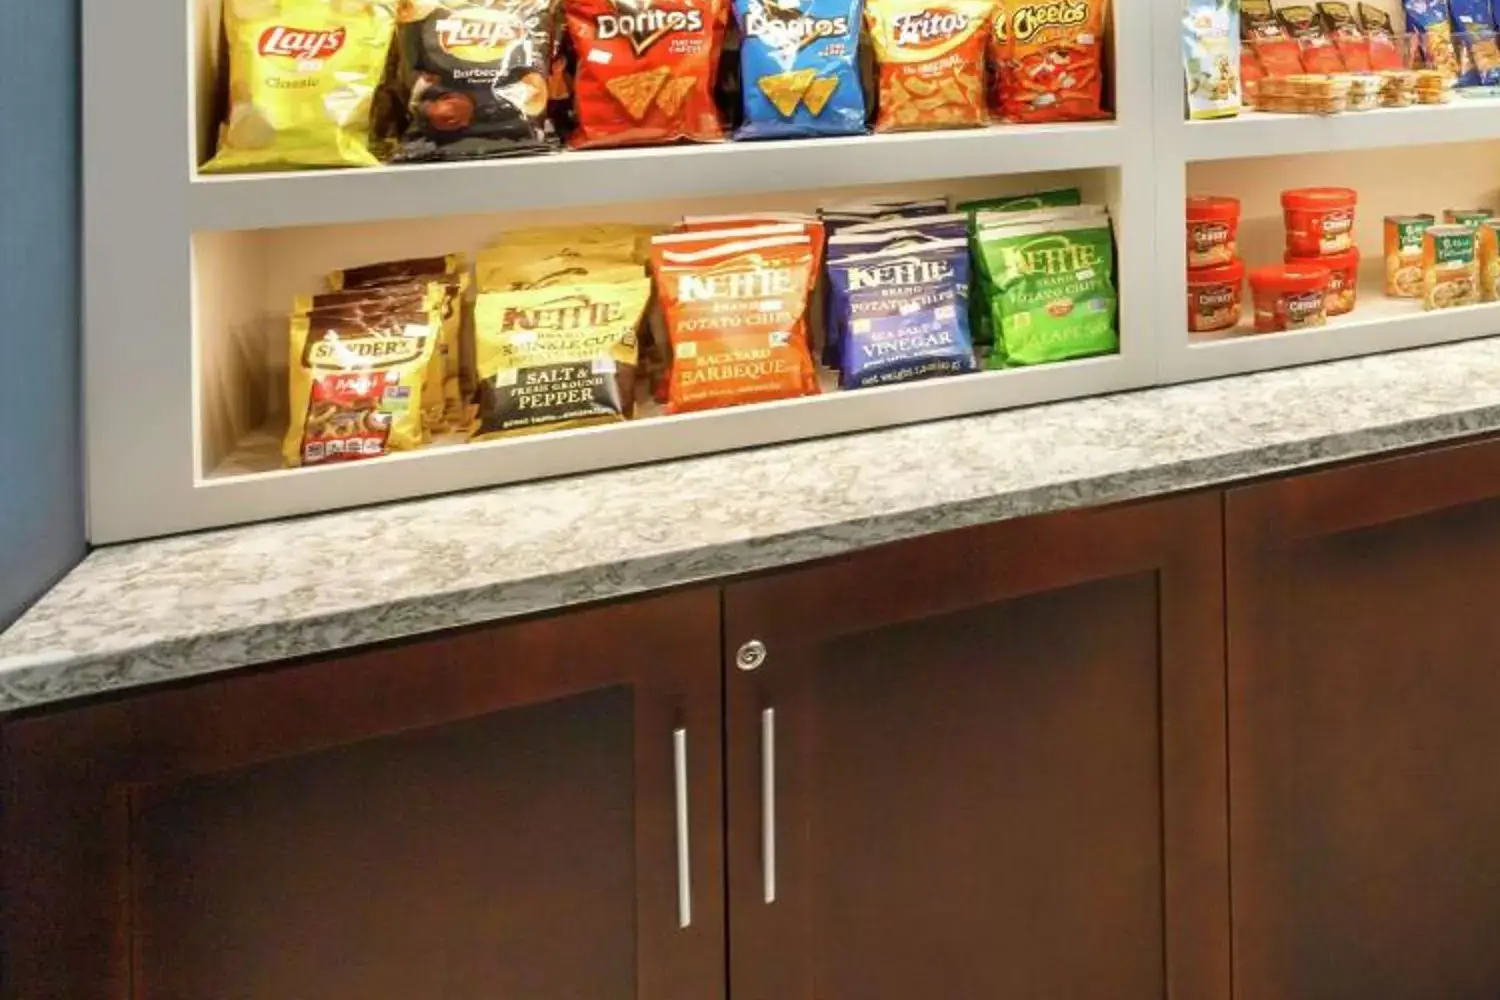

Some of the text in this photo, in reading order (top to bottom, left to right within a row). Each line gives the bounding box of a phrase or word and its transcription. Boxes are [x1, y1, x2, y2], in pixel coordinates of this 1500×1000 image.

[597, 9, 702, 39] Doritos
[895, 10, 968, 46] Fritos
[1013, 0, 1088, 42] Cheetos
[1001, 245, 1104, 278] KETTLE
[677, 268, 795, 303] KETTLE
[844, 262, 954, 292] KETTLE
[677, 316, 742, 333] POTATO
[863, 331, 953, 357] VINEGAR
[526, 367, 589, 385] SALT &
[551, 376, 604, 393] GROUND
[681, 360, 787, 385] BARBEQUE
[518, 386, 595, 410] PEPPER
